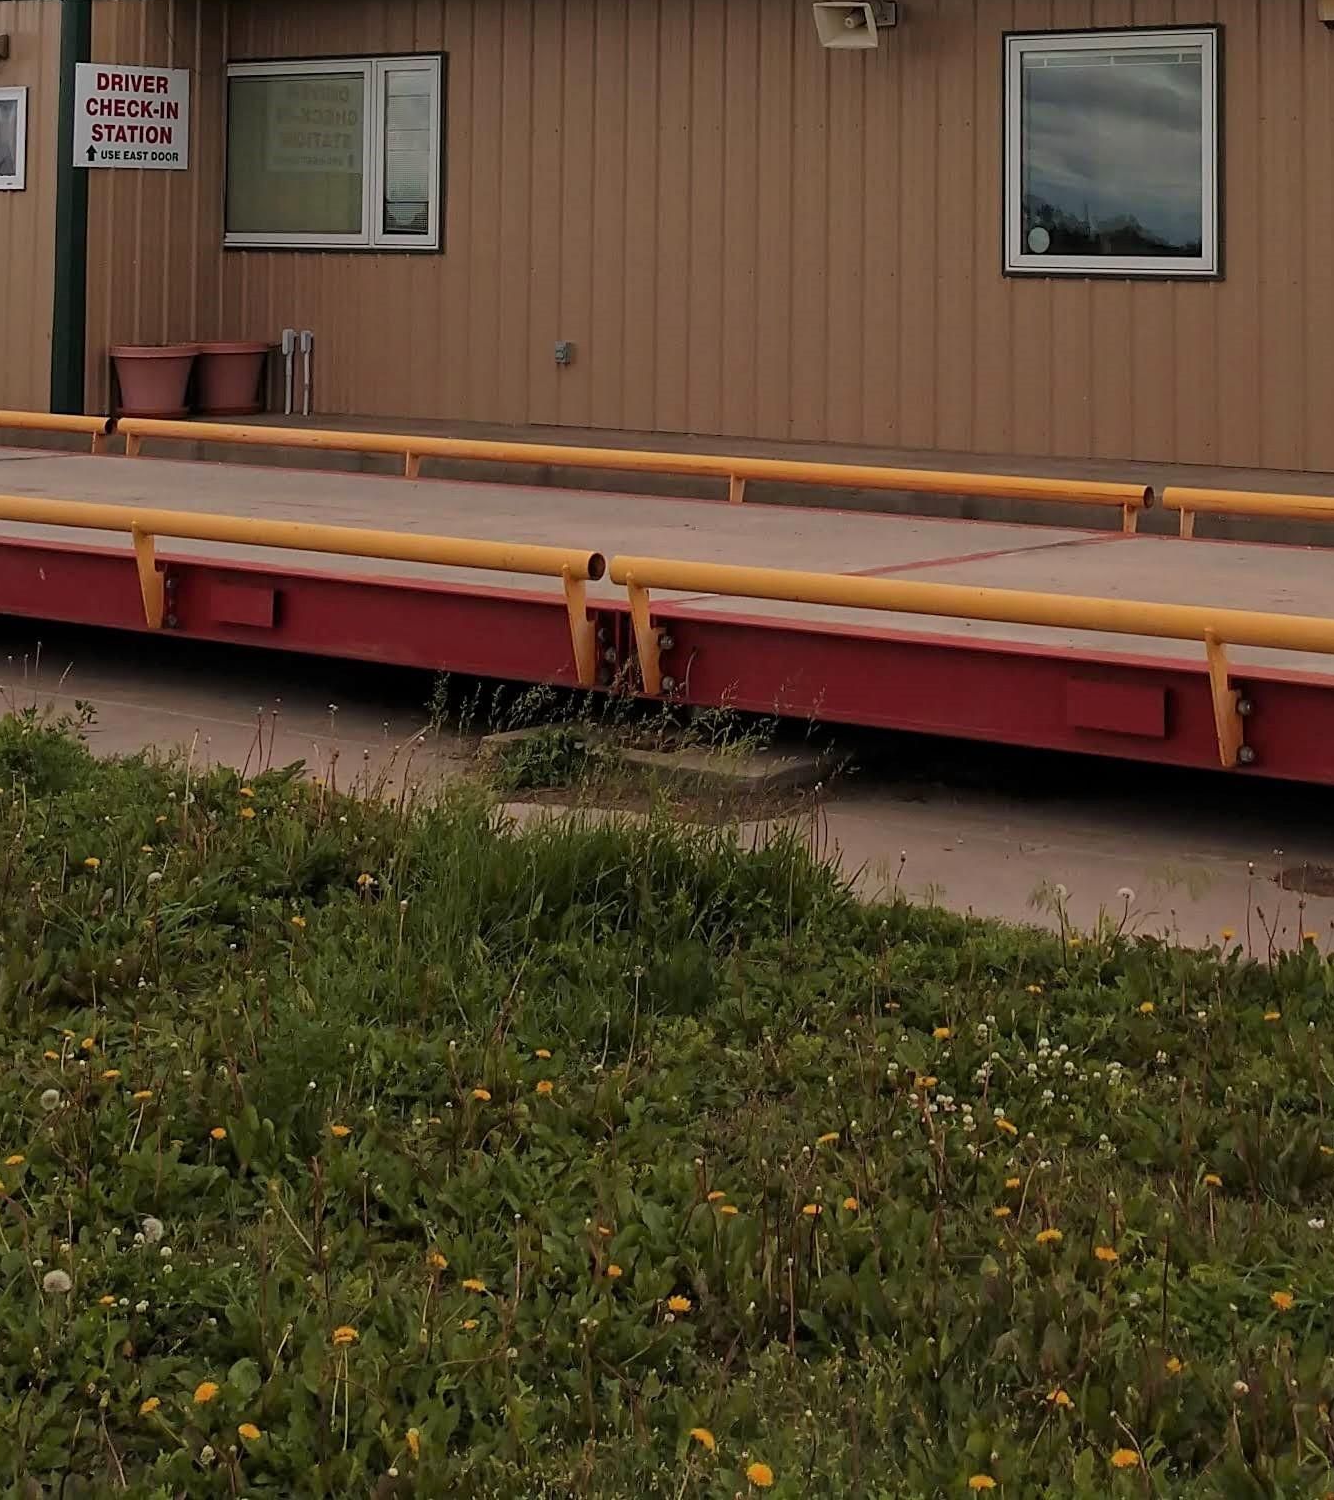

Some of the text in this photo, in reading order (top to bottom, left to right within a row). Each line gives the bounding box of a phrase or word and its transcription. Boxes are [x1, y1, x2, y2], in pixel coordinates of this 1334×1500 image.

[97, 72, 169, 94] DRIVER
[86, 97, 179, 120] CHECK-IN
[91, 123, 172, 145] STATION
[100, 150, 179, 162] USE EAST DOOR
